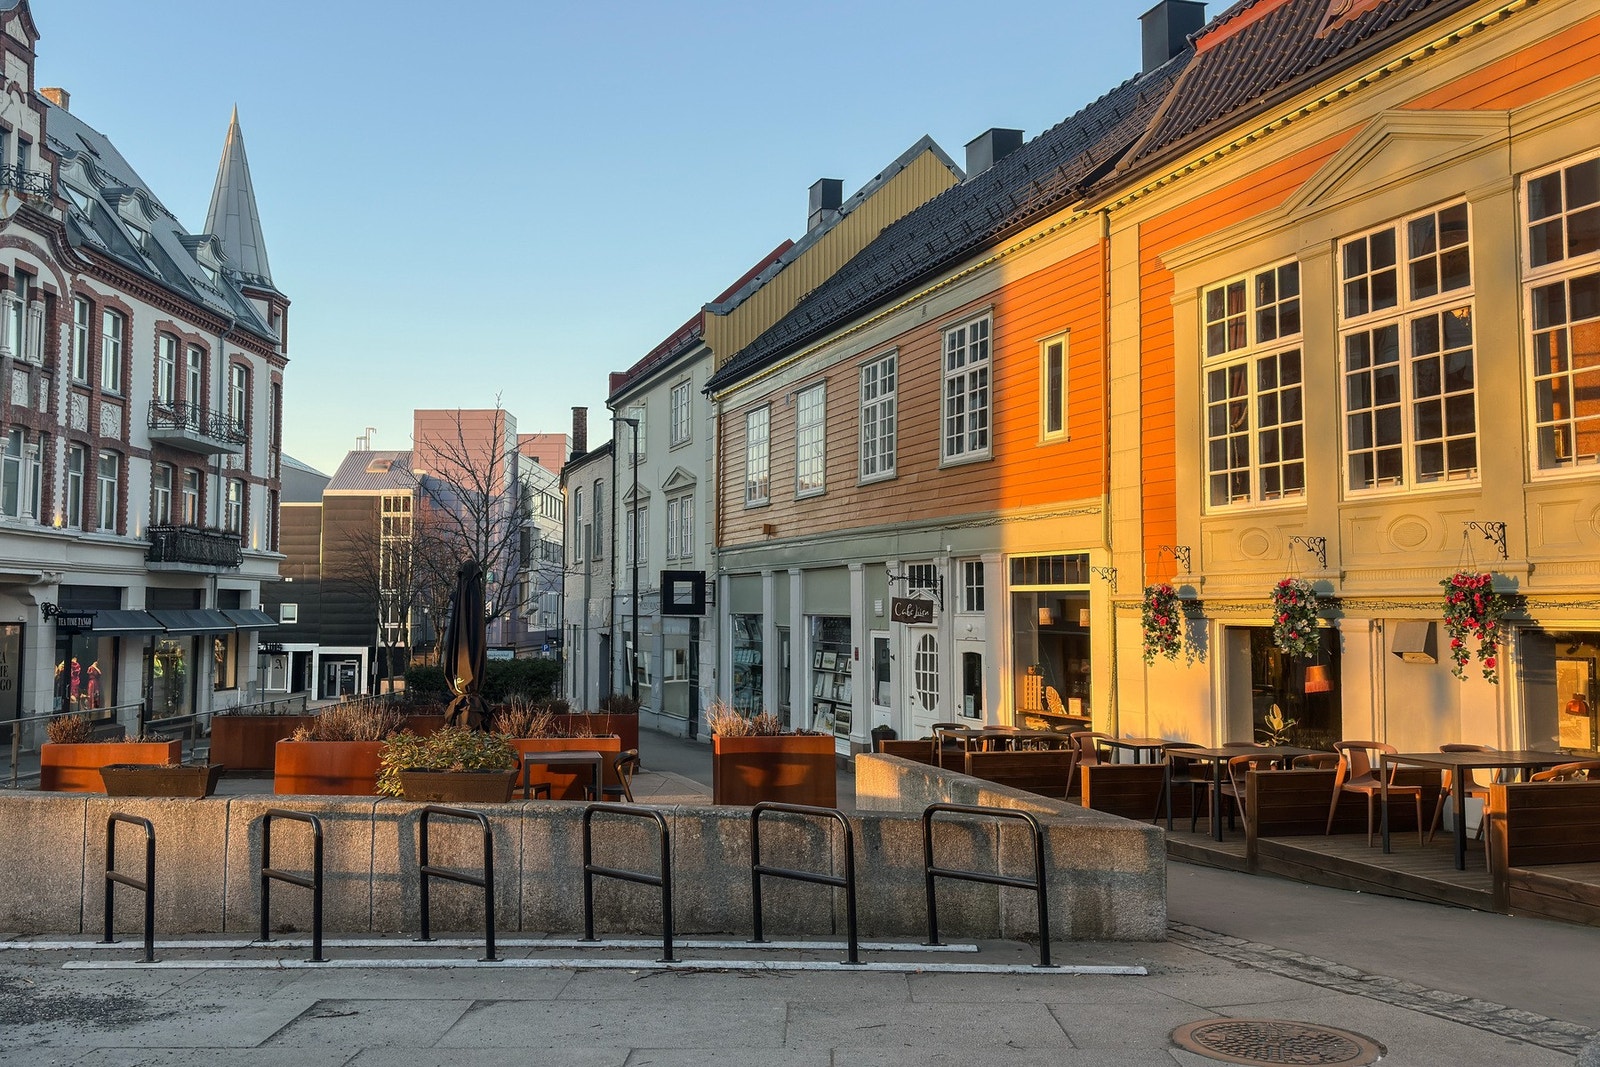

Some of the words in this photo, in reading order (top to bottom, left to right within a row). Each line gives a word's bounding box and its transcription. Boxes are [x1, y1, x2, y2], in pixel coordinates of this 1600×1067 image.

[58, 617, 67, 626] TEA
[66, 617, 78, 626] TIME
[78, 617, 92, 626] TANGO
